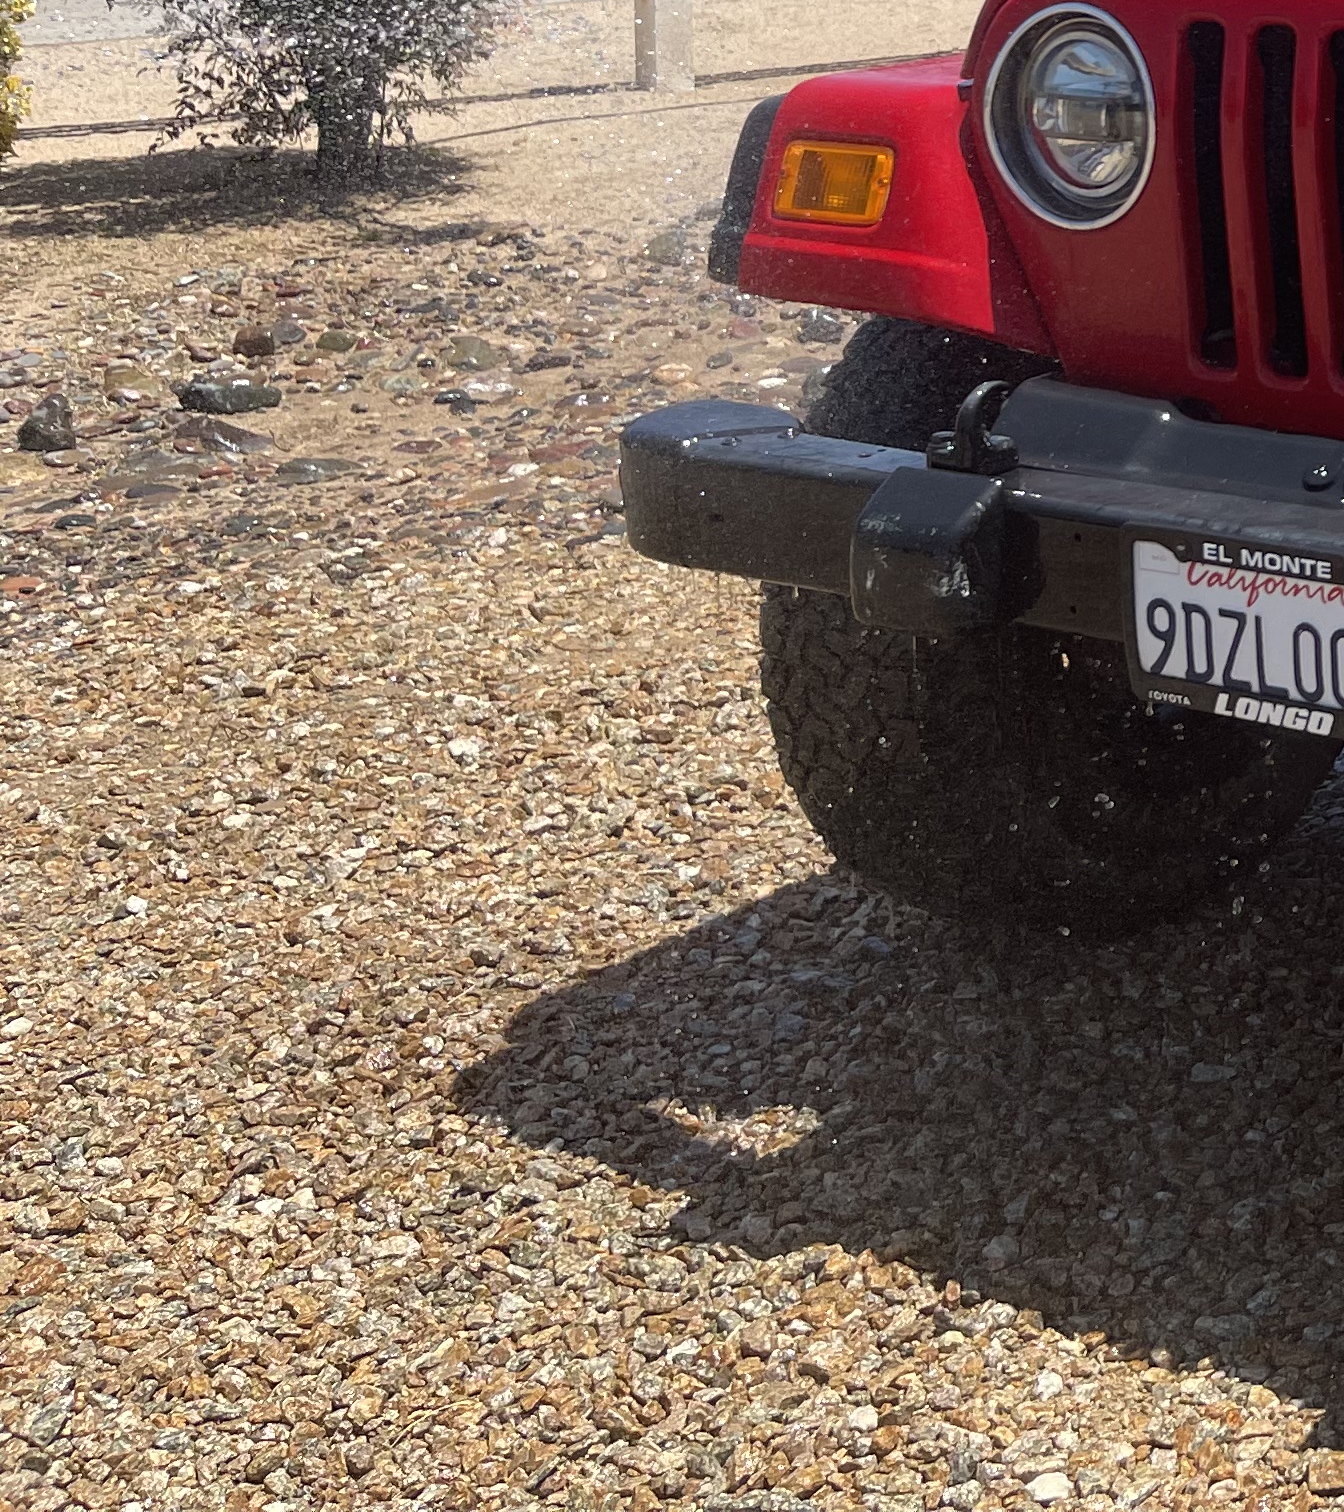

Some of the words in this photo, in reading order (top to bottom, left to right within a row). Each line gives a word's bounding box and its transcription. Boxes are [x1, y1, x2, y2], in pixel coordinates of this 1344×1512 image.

[1202, 542, 1233, 564] EL
[1240, 548, 1332, 580] MONTE
[1148, 689, 1192, 706] TOYOTA
[1213, 692, 1335, 737] LONGO
